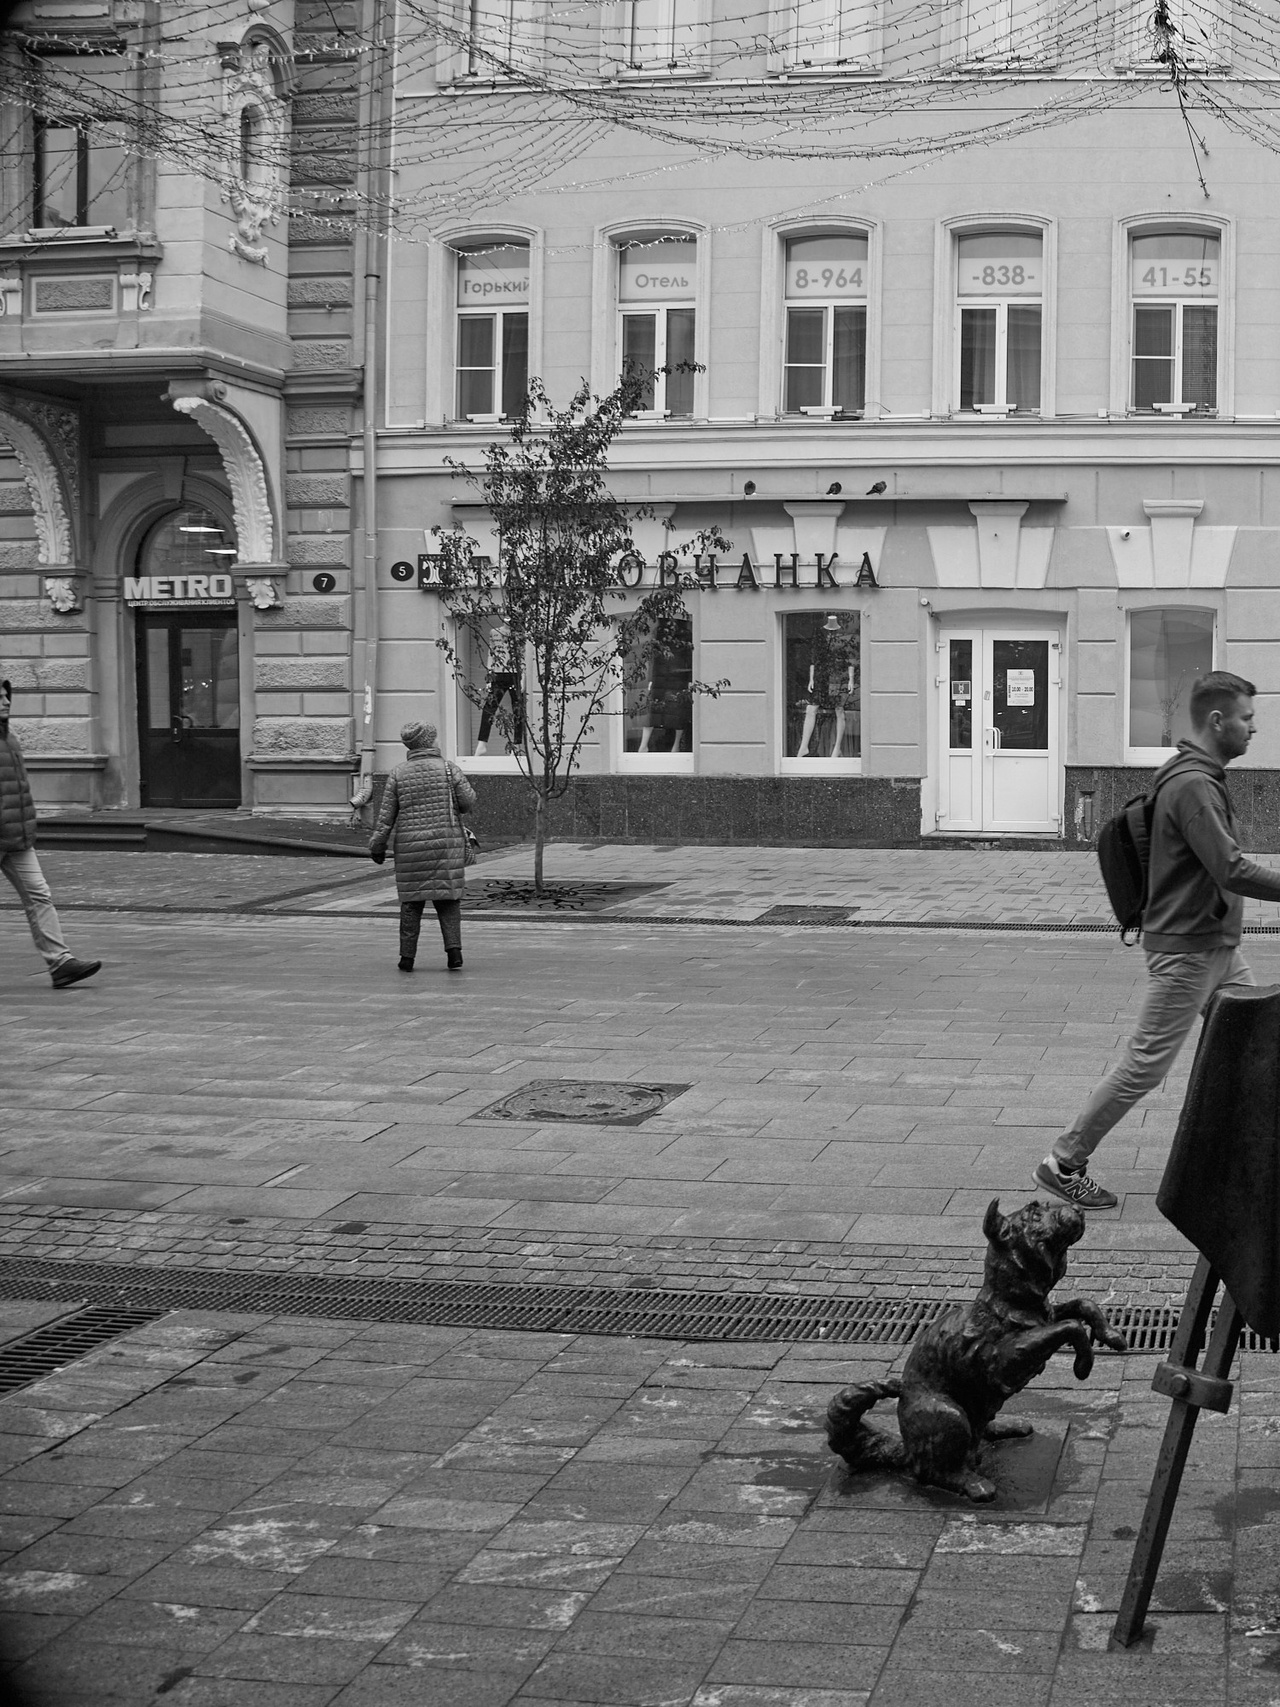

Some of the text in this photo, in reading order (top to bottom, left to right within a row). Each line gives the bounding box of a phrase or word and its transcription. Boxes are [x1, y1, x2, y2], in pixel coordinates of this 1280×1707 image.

[635, 273, 689, 288] Отель
[795, 267, 863, 289] 8-964
[972, 265, 1036, 286] -838-
[1142, 266, 1212, 287] 41-55
[398, 566, 406, 576] 5
[124, 574, 232, 600] METRO
[320, 577, 329, 588] 7
[1065, 1182, 1089, 1200] N
